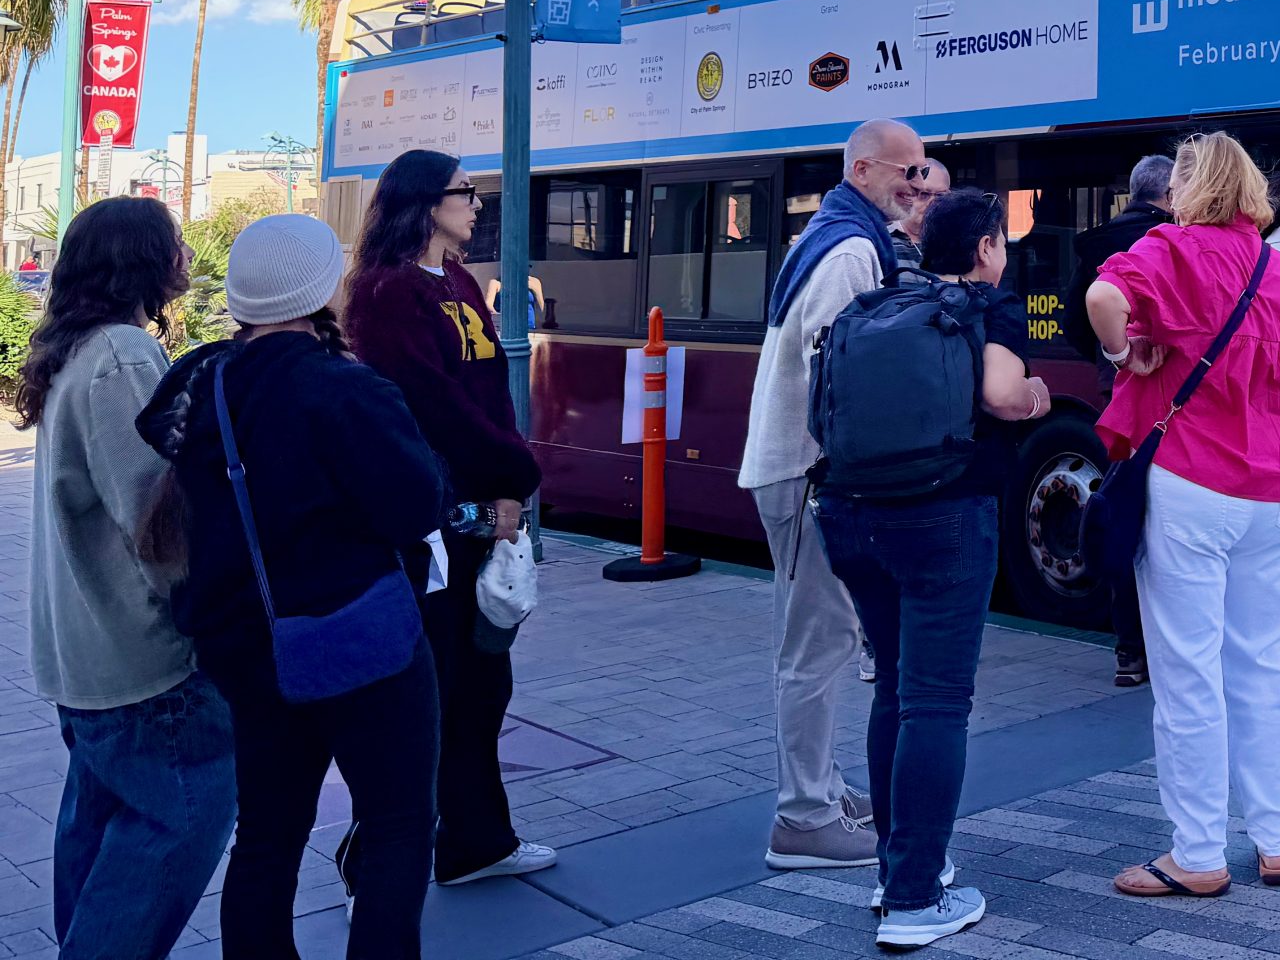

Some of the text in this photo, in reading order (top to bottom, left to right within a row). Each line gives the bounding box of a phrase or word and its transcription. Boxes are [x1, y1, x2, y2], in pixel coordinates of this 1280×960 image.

[100, 8, 132, 20] Palm
[820, 4, 838, 14] Grand
[92, 23, 137, 40] Springs
[949, 21, 1088, 57] FERGUSON HOME
[1179, 39, 1280, 66] February
[640, 56, 663, 64] DESIGN
[640, 66, 663, 74] WITHIN
[547, 75, 566, 90] koffi
[748, 69, 793, 89] BRIZO
[816, 72, 842, 82] PAINTS
[83, 85, 136, 97] CANADA
[868, 80, 910, 91] MONOGRAM
[1027, 294, 1065, 315] HOP-
